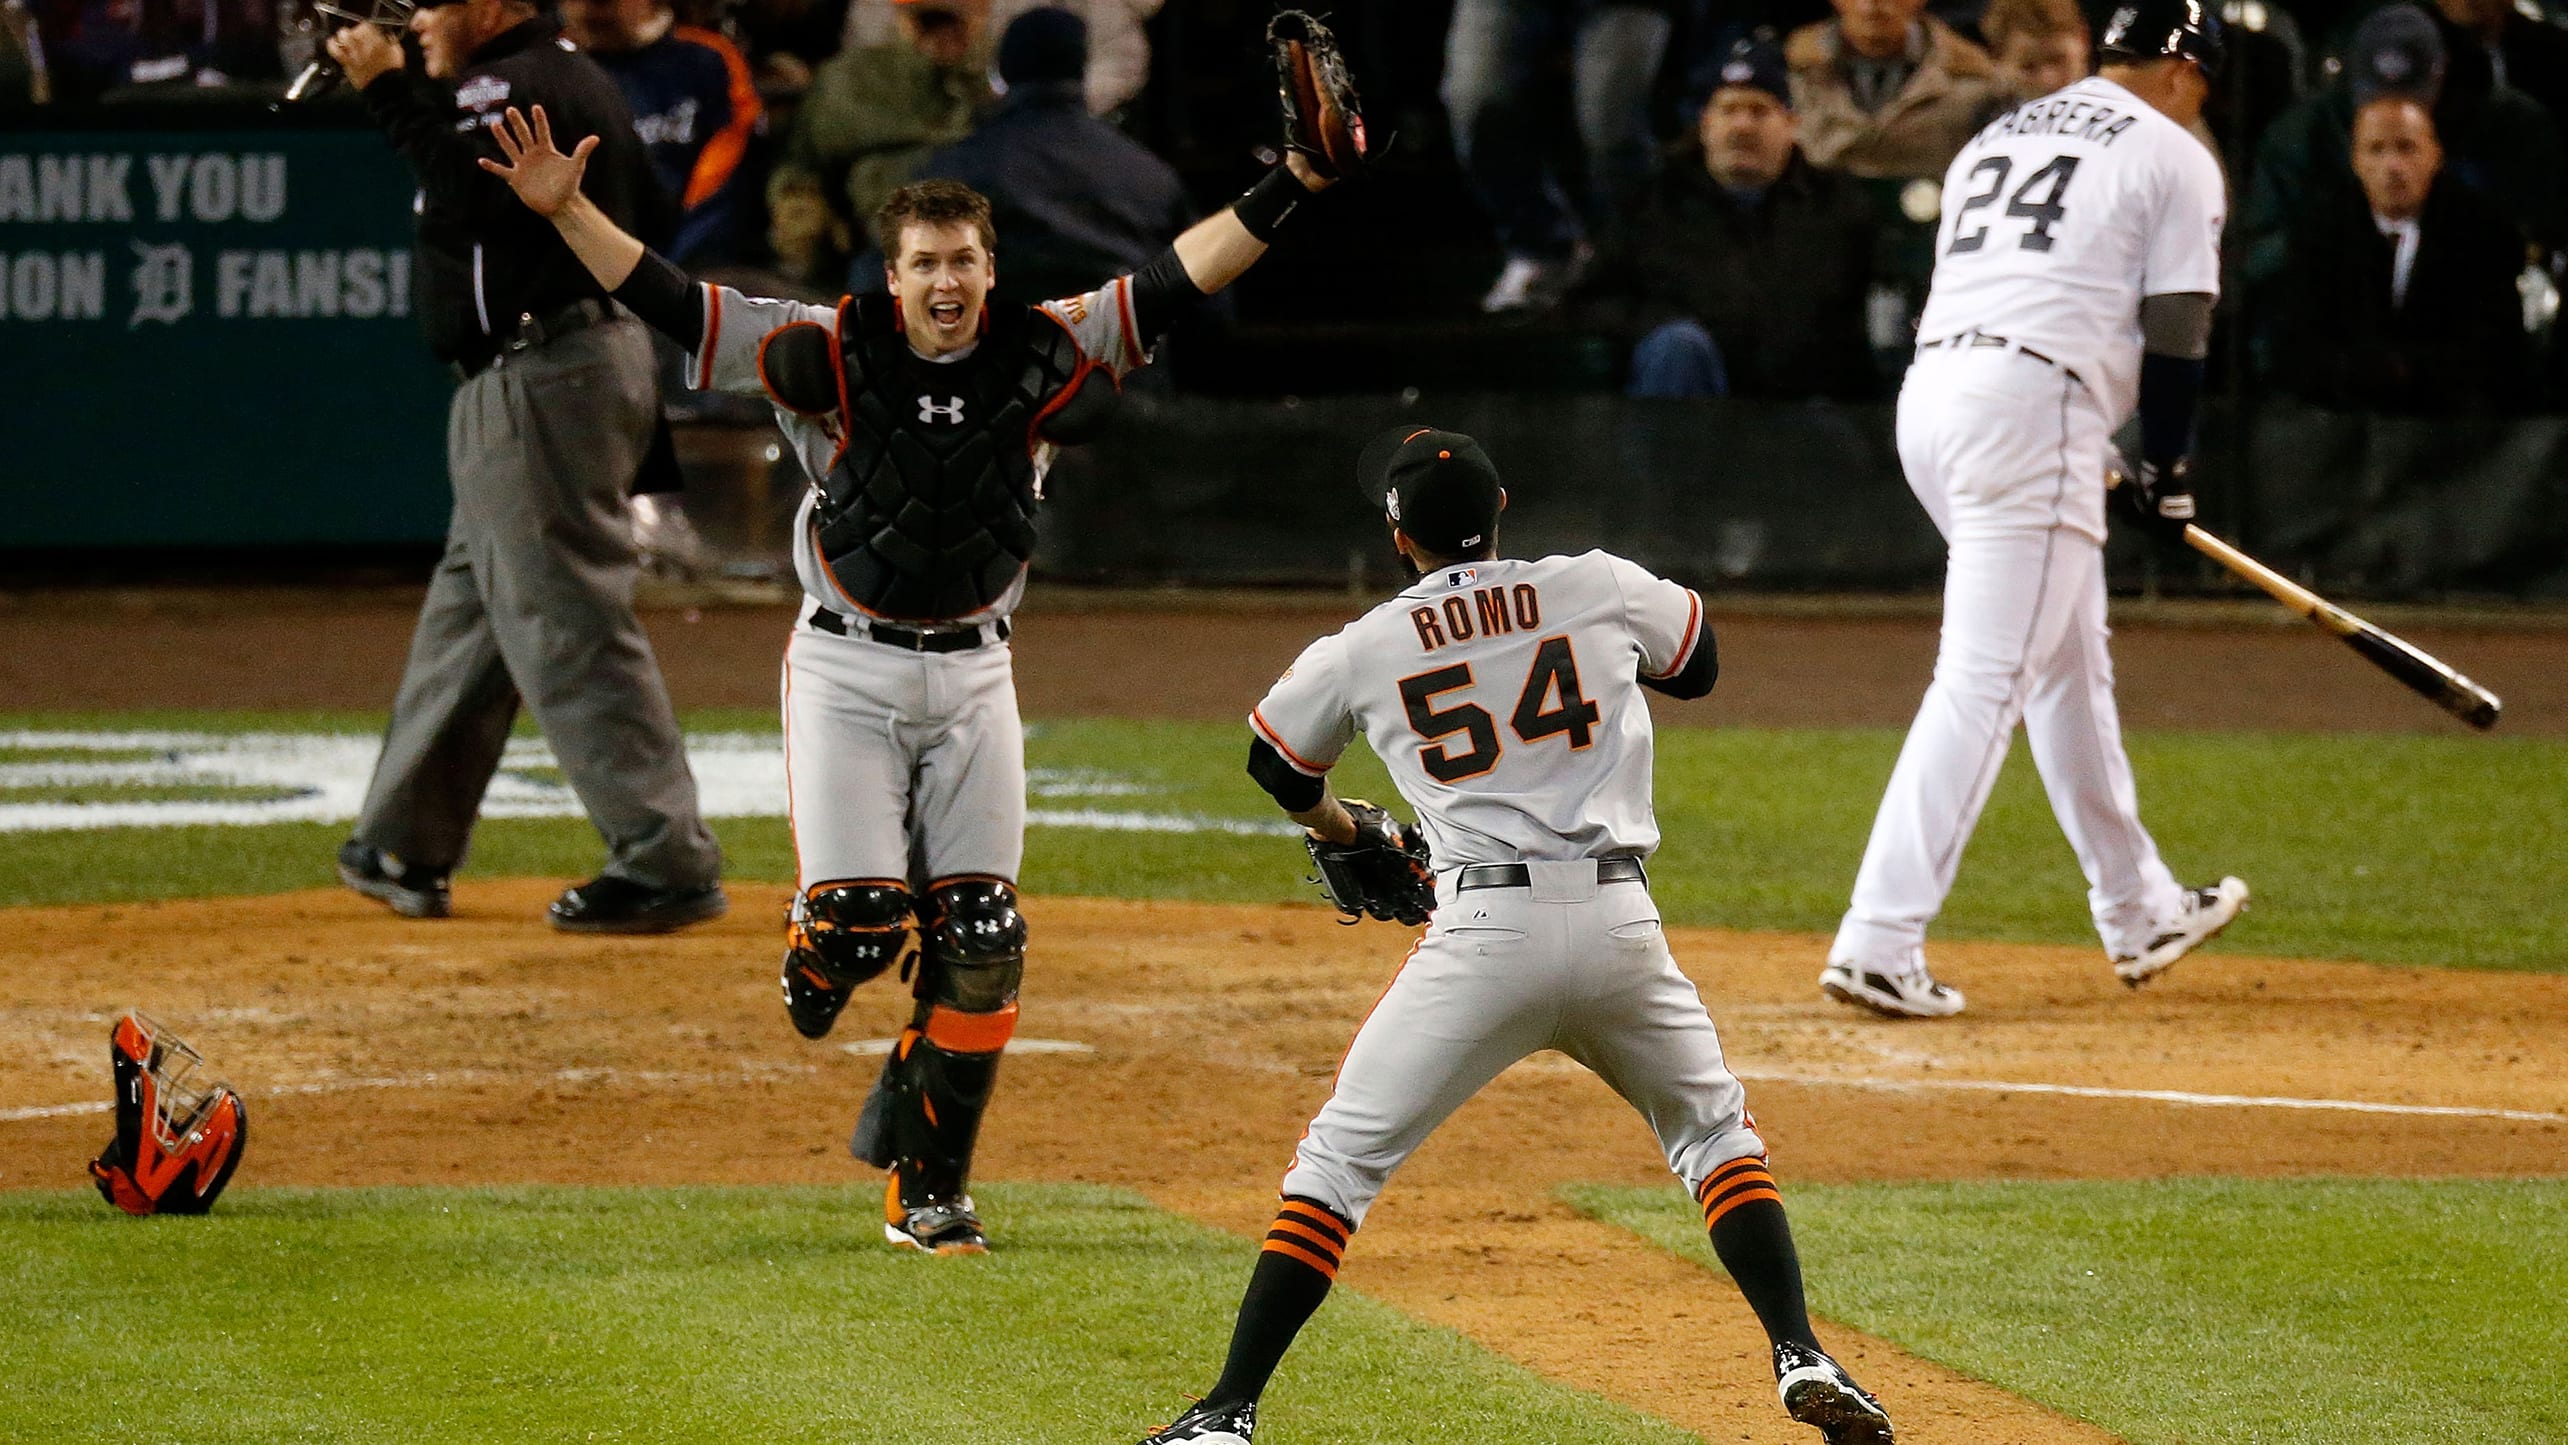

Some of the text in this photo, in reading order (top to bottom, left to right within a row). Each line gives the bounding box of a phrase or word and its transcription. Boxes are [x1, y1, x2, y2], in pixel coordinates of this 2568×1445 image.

[0, 153, 287, 223] ANK YOU
[1946, 155, 2080, 254] 24
[217, 249, 410, 320] FANS!
[1410, 583, 1541, 651] ROMO
[1397, 634, 1600, 784] 54
